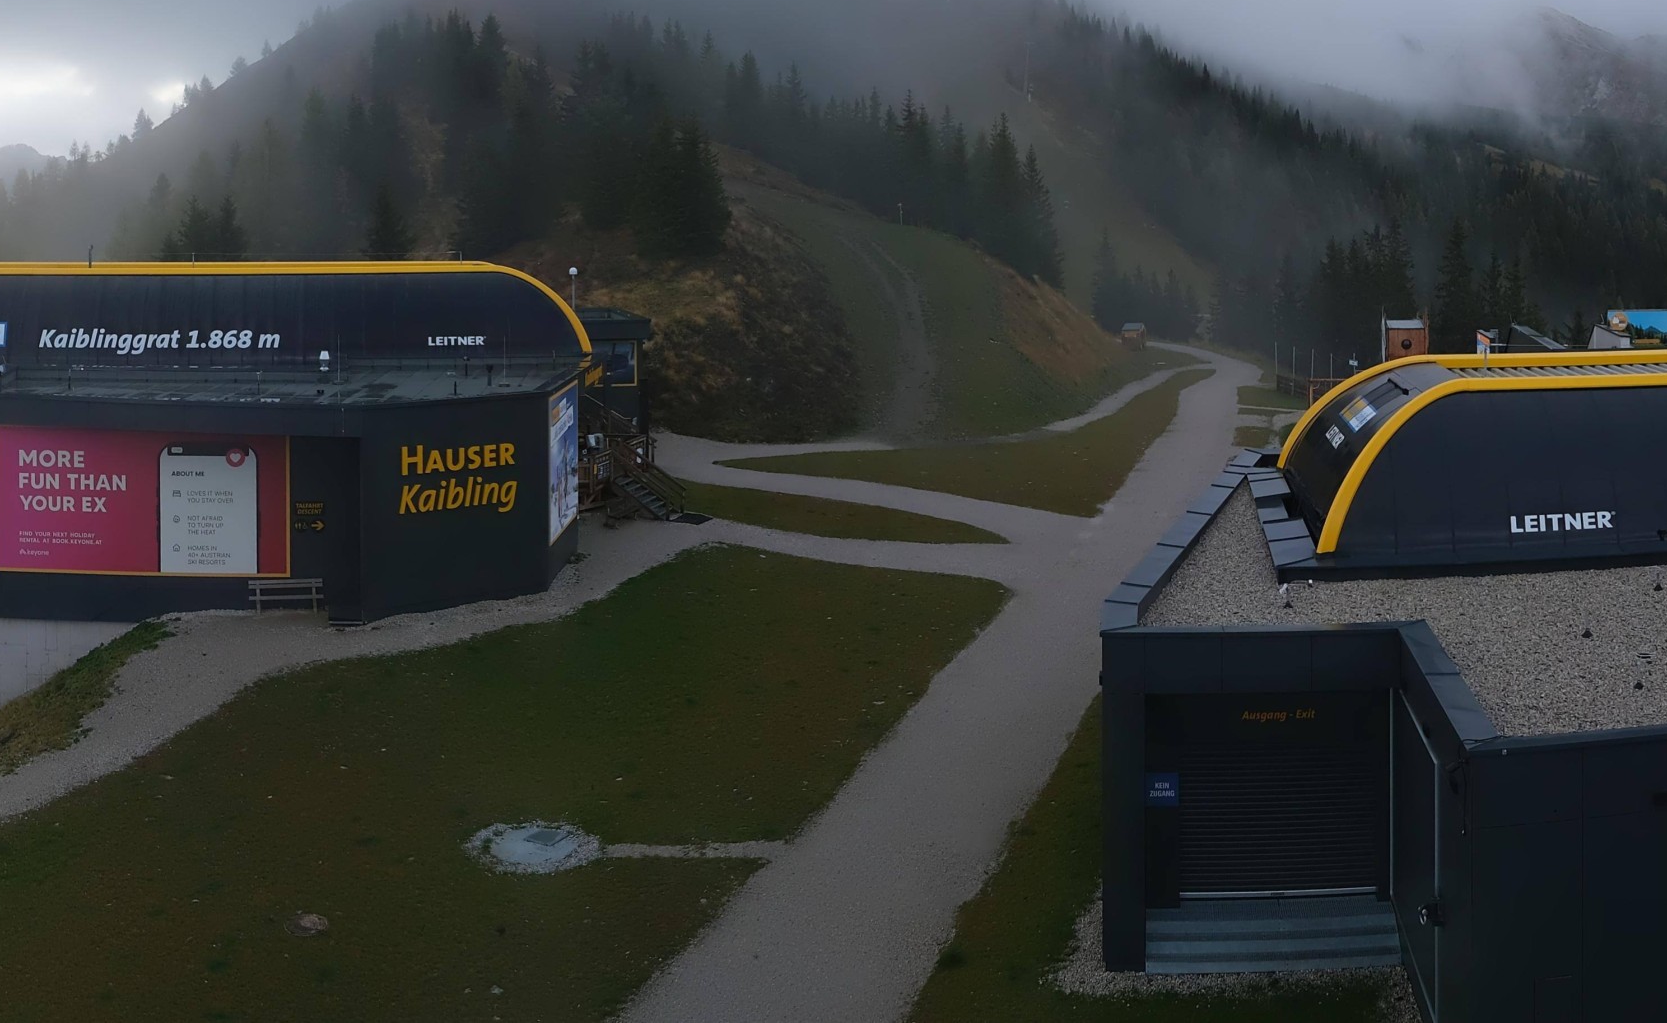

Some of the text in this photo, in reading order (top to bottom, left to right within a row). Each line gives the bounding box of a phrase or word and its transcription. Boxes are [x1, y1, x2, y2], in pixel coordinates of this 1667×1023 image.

[38, 328, 280, 355] Kaiblinggrat 1.868 m
[428, 336, 485, 346] LEITNER
[19, 449, 85, 468] MORE
[401, 443, 515, 475] HAUSER
[19, 472, 126, 491] FUN THAN
[20, 495, 107, 513] YOUR EX
[399, 477, 517, 514] Kaibling
[1510, 511, 1613, 533] LEITNER
[1242, 710, 1287, 722] Ausgang
[1296, 708, 1315, 719] Exit
